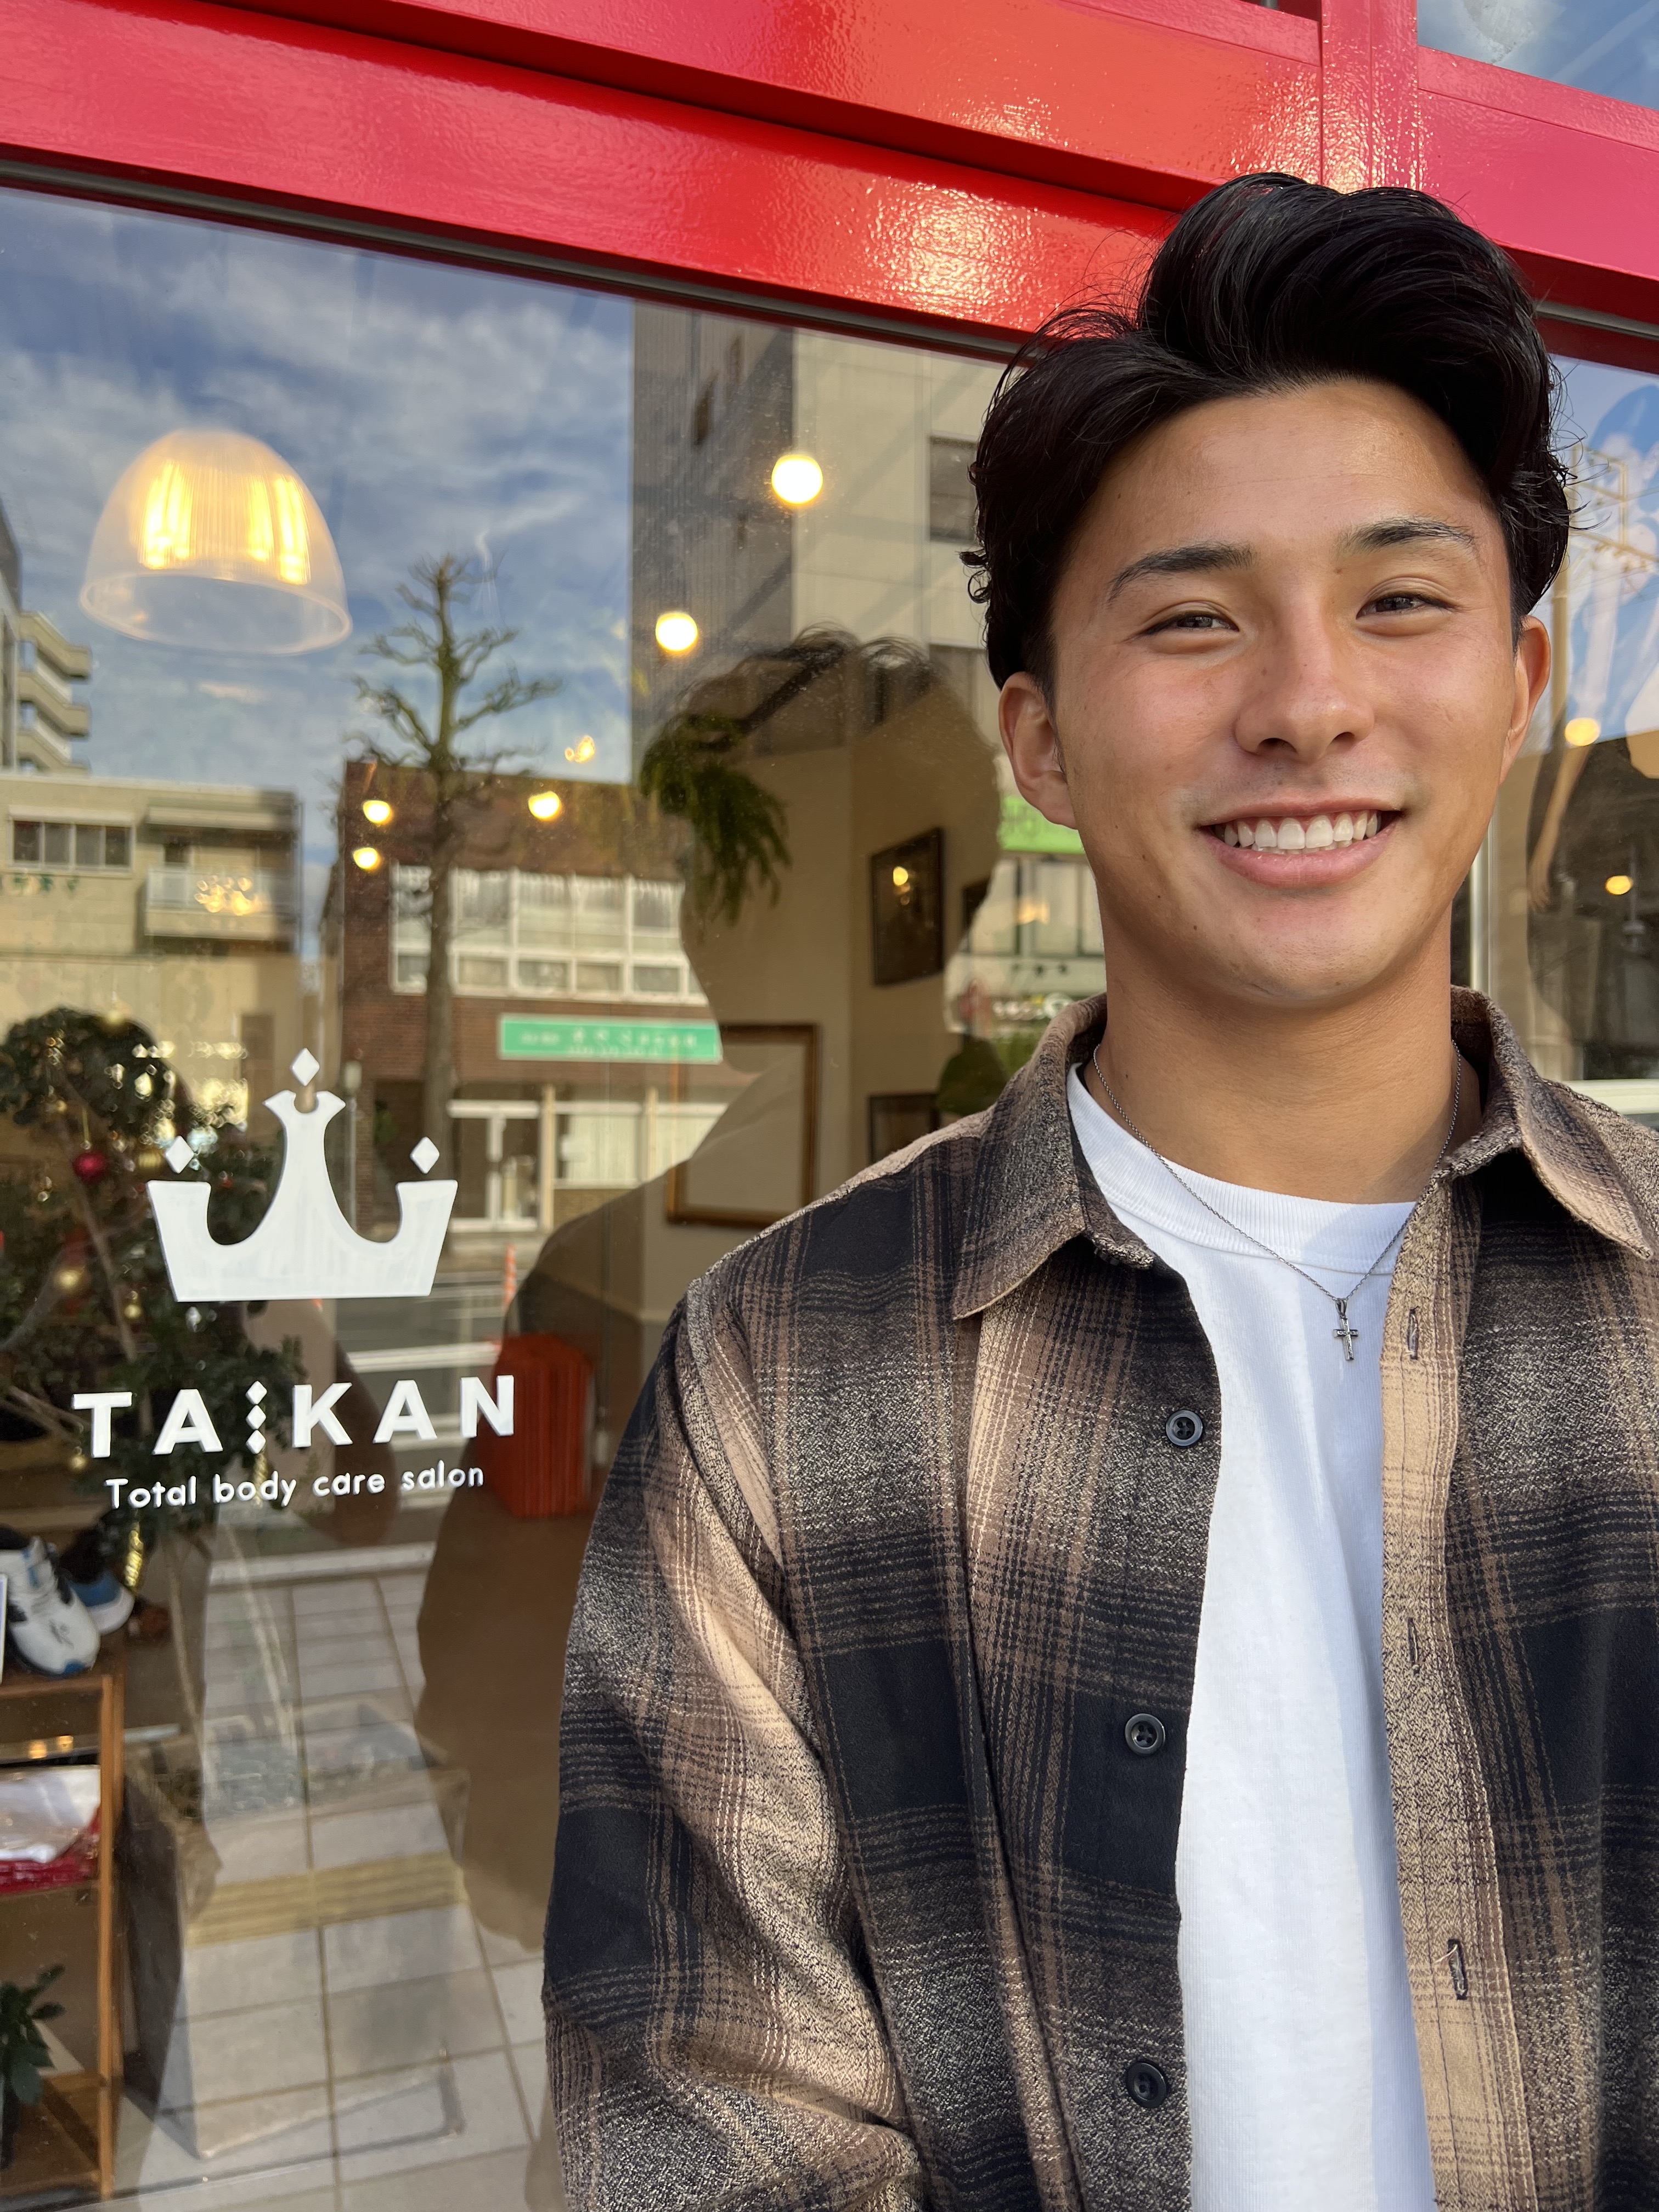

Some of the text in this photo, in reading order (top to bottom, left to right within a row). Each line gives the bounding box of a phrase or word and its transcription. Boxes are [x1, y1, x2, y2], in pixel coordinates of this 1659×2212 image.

[105, 1460, 484, 1509] Total body care salon
